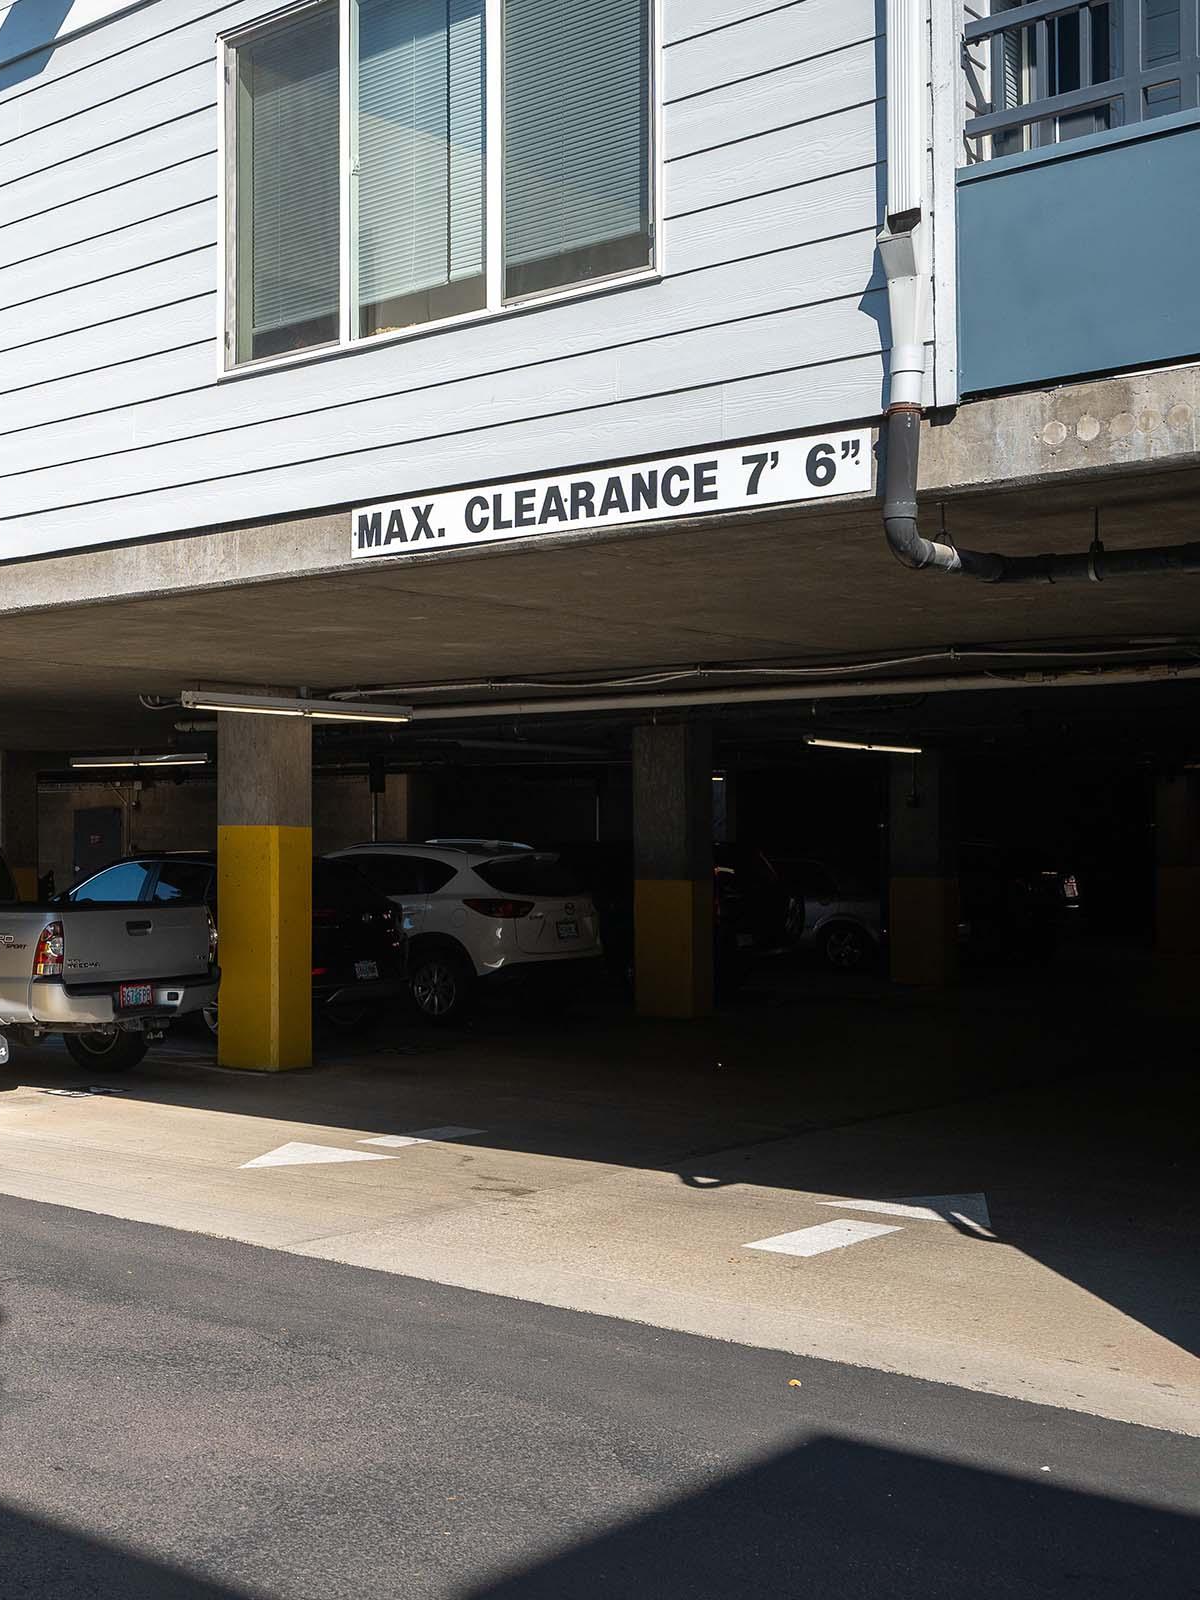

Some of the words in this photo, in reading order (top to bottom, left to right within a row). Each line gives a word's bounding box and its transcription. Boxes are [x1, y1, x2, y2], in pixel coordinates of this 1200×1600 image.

[357, 504, 445, 549] MAX.
[464, 460, 718, 533] CLEARANCE
[741, 451, 779, 496] 7'
